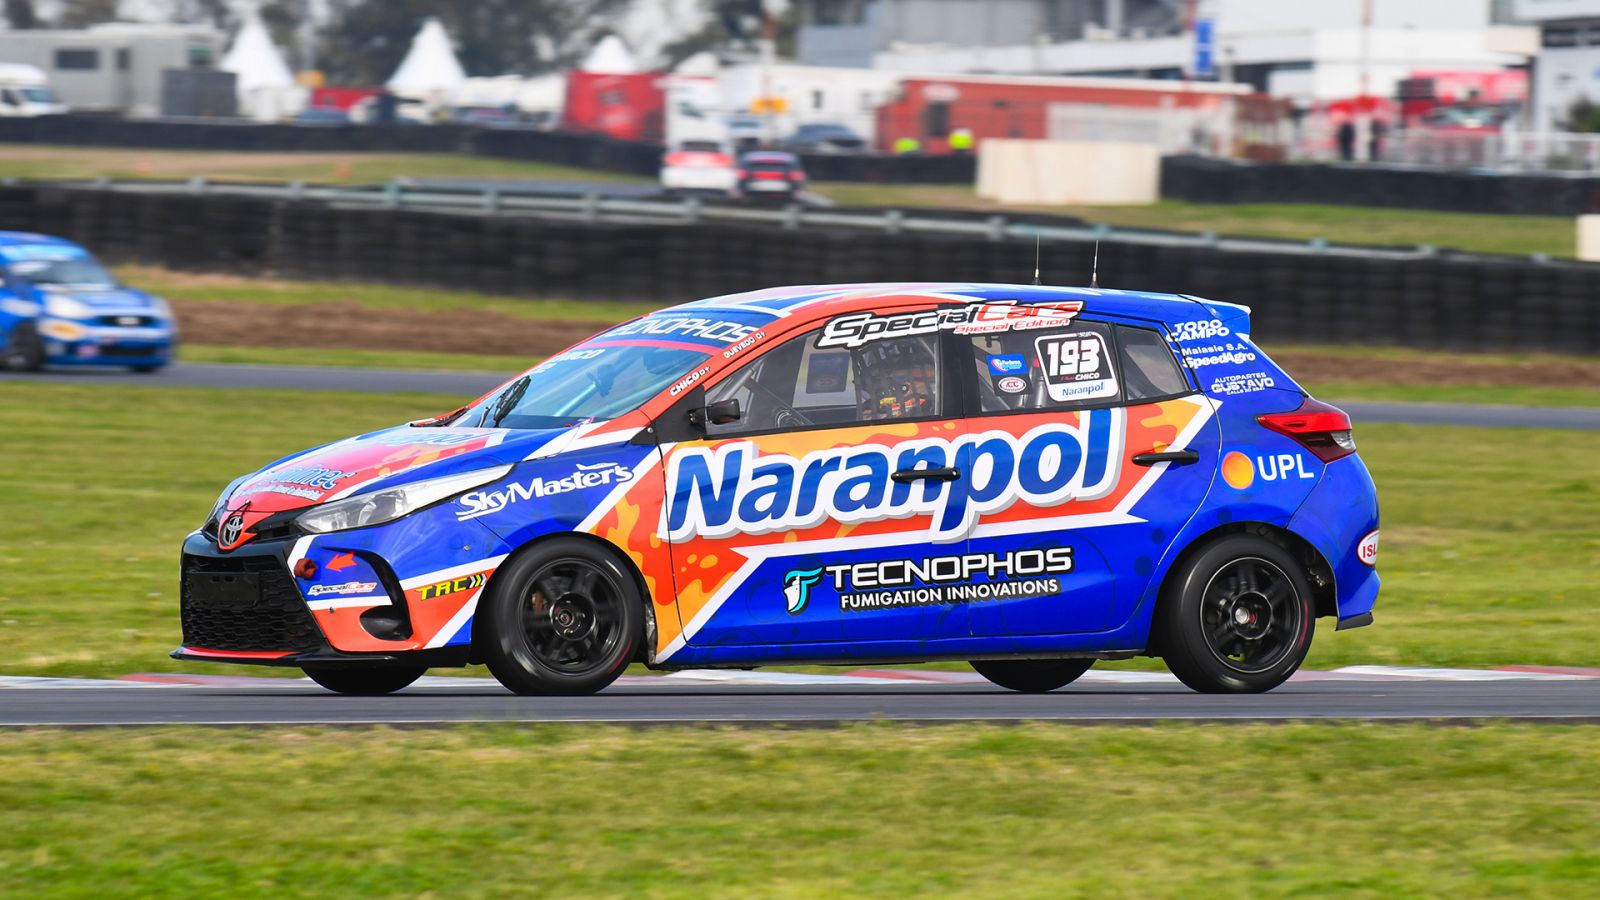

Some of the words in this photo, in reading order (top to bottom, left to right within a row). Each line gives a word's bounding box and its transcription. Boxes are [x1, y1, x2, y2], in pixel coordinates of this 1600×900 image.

[954, 322, 1009, 335] Special
[1013, 318, 1070, 330] Edition
[1174, 319, 1222, 332] TODO
[1165, 327, 1230, 342] CAMPO
[1225, 343, 1248, 351] S.A.
[1047, 339, 1100, 376] 193
[1182, 352, 1256, 369] SpeedAgro
[669, 372, 701, 396] CHICO
[1075, 372, 1100, 380] CHICO
[1215, 372, 1267, 384] AUTOPARTES
[1062, 381, 1104, 396] Naranpol
[1211, 377, 1275, 393] GUSTAVO
[667, 409, 1113, 532] Naranpol
[1257, 454, 1314, 480] UPL
[825, 548, 1072, 589] TECNOPHOS
[840, 587, 942, 609] FUMIGATION
[947, 579, 1058, 600] INNOVATIONS
